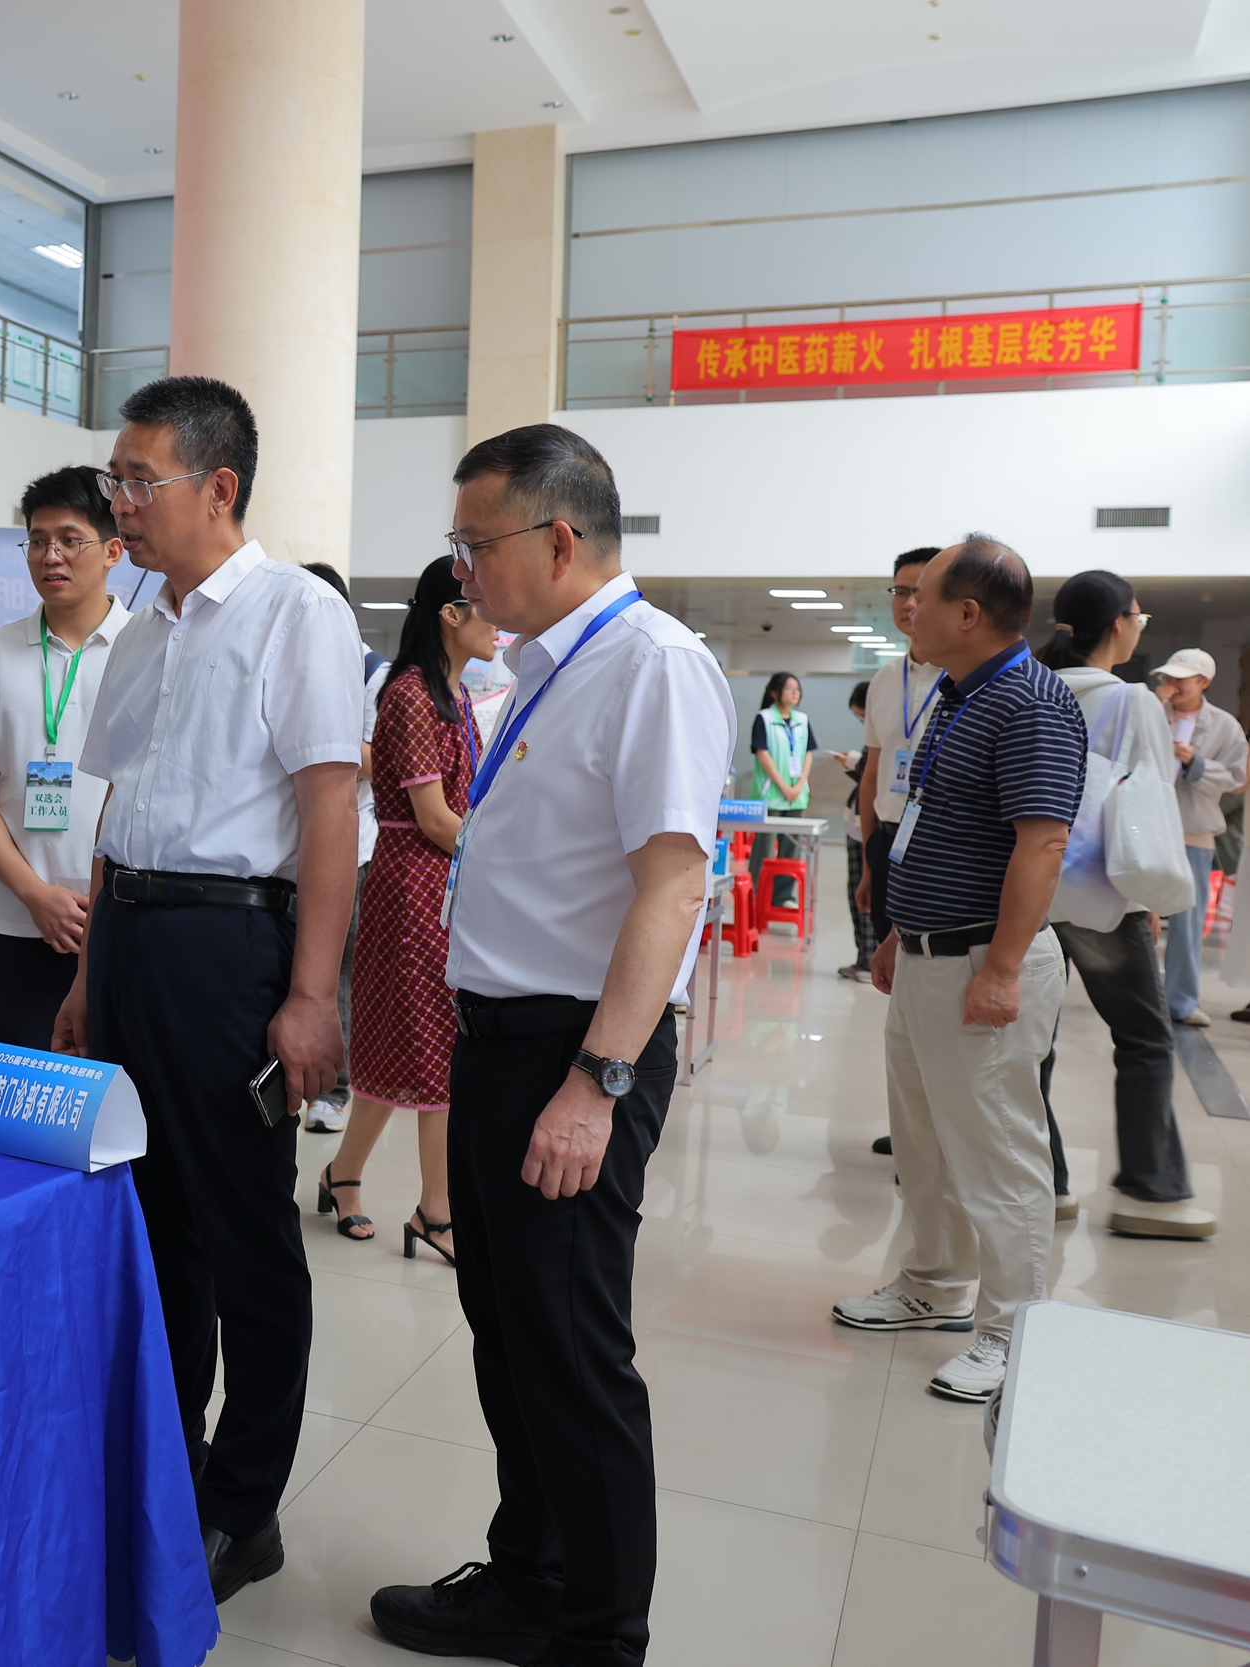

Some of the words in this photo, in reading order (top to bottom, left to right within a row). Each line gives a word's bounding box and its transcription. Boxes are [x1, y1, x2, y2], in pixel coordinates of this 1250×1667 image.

[696, 330, 886, 379] 传承中医药薪火
[908, 315, 1118, 370] 扎根基层绽芳华
[34, 793, 63, 804] 双选会
[28, 805, 68, 817] 工作人员
